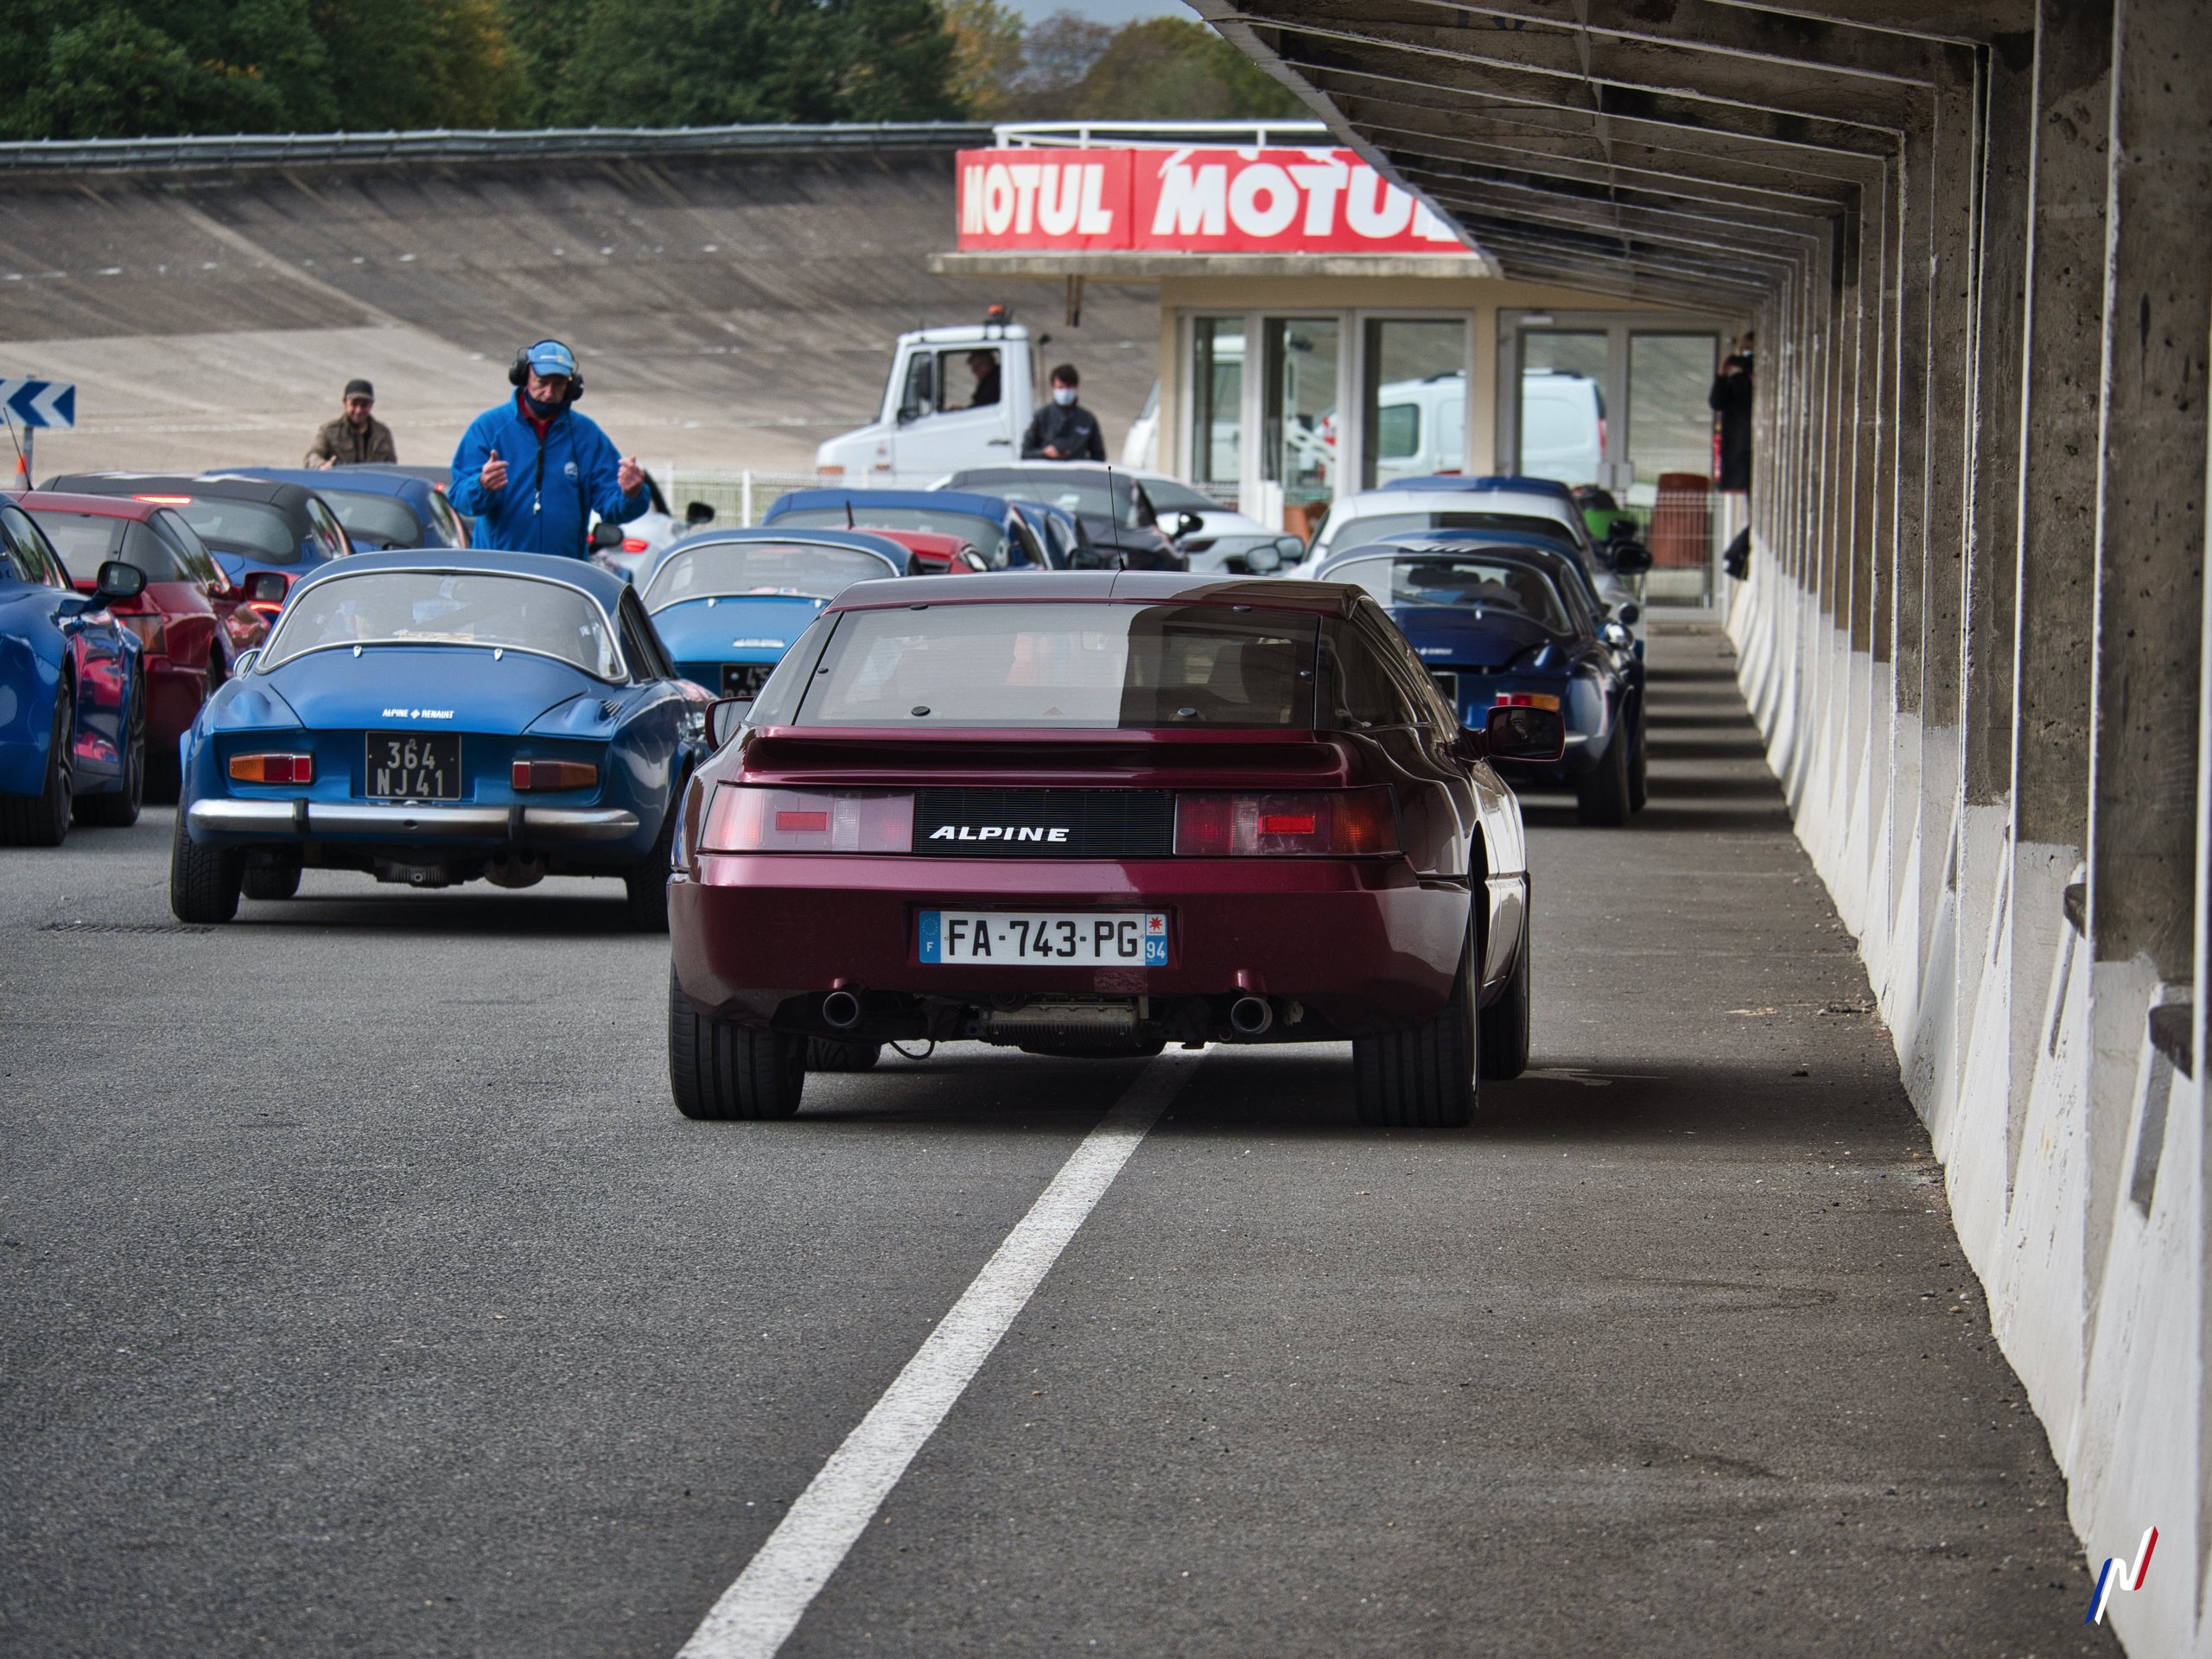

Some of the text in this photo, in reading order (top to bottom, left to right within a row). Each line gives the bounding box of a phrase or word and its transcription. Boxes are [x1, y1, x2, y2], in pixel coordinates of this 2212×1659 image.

[963, 163, 1114, 236] MOTUL
[382, 709, 454, 719] ALPINE RENAULT
[387, 741, 435, 770] 364
[929, 825, 1070, 842] ALPINE
[926, 920, 1166, 959] F FA-743-PG 94
